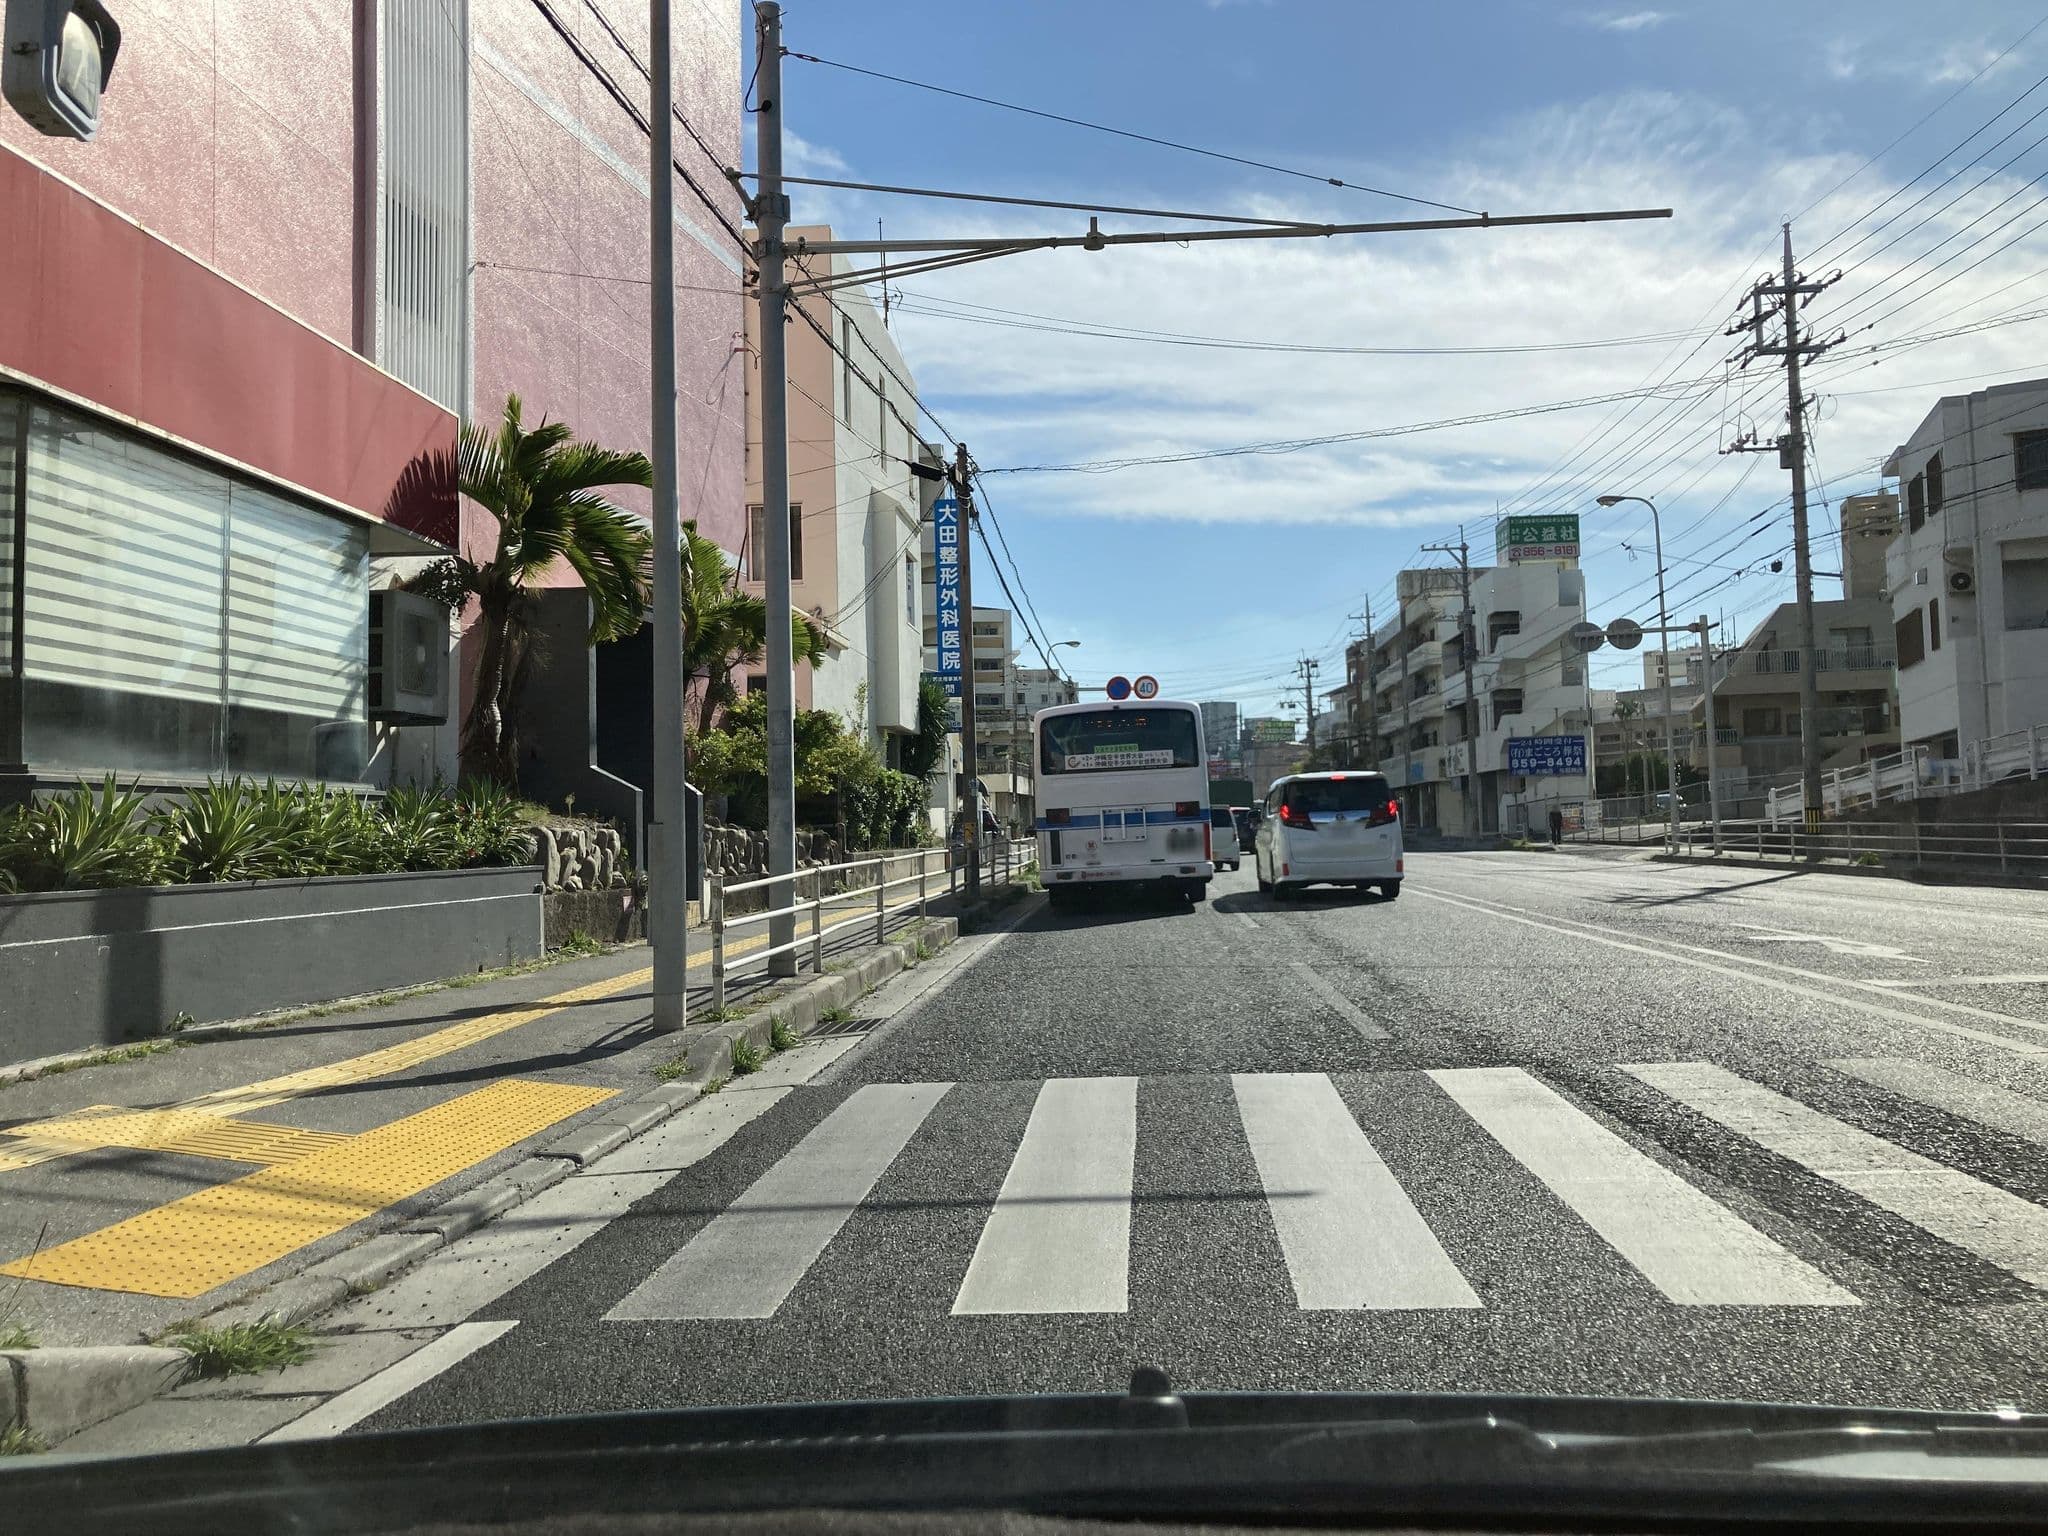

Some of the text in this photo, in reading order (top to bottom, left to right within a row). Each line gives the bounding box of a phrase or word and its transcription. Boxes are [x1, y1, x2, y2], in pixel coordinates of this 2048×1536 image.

[1522, 525, 1577, 542] 公益社
[938, 504, 961, 670] 大田整形外科医院
[1140, 682, 1153, 693] 40
[1511, 757, 1581, 768] 859-8494
